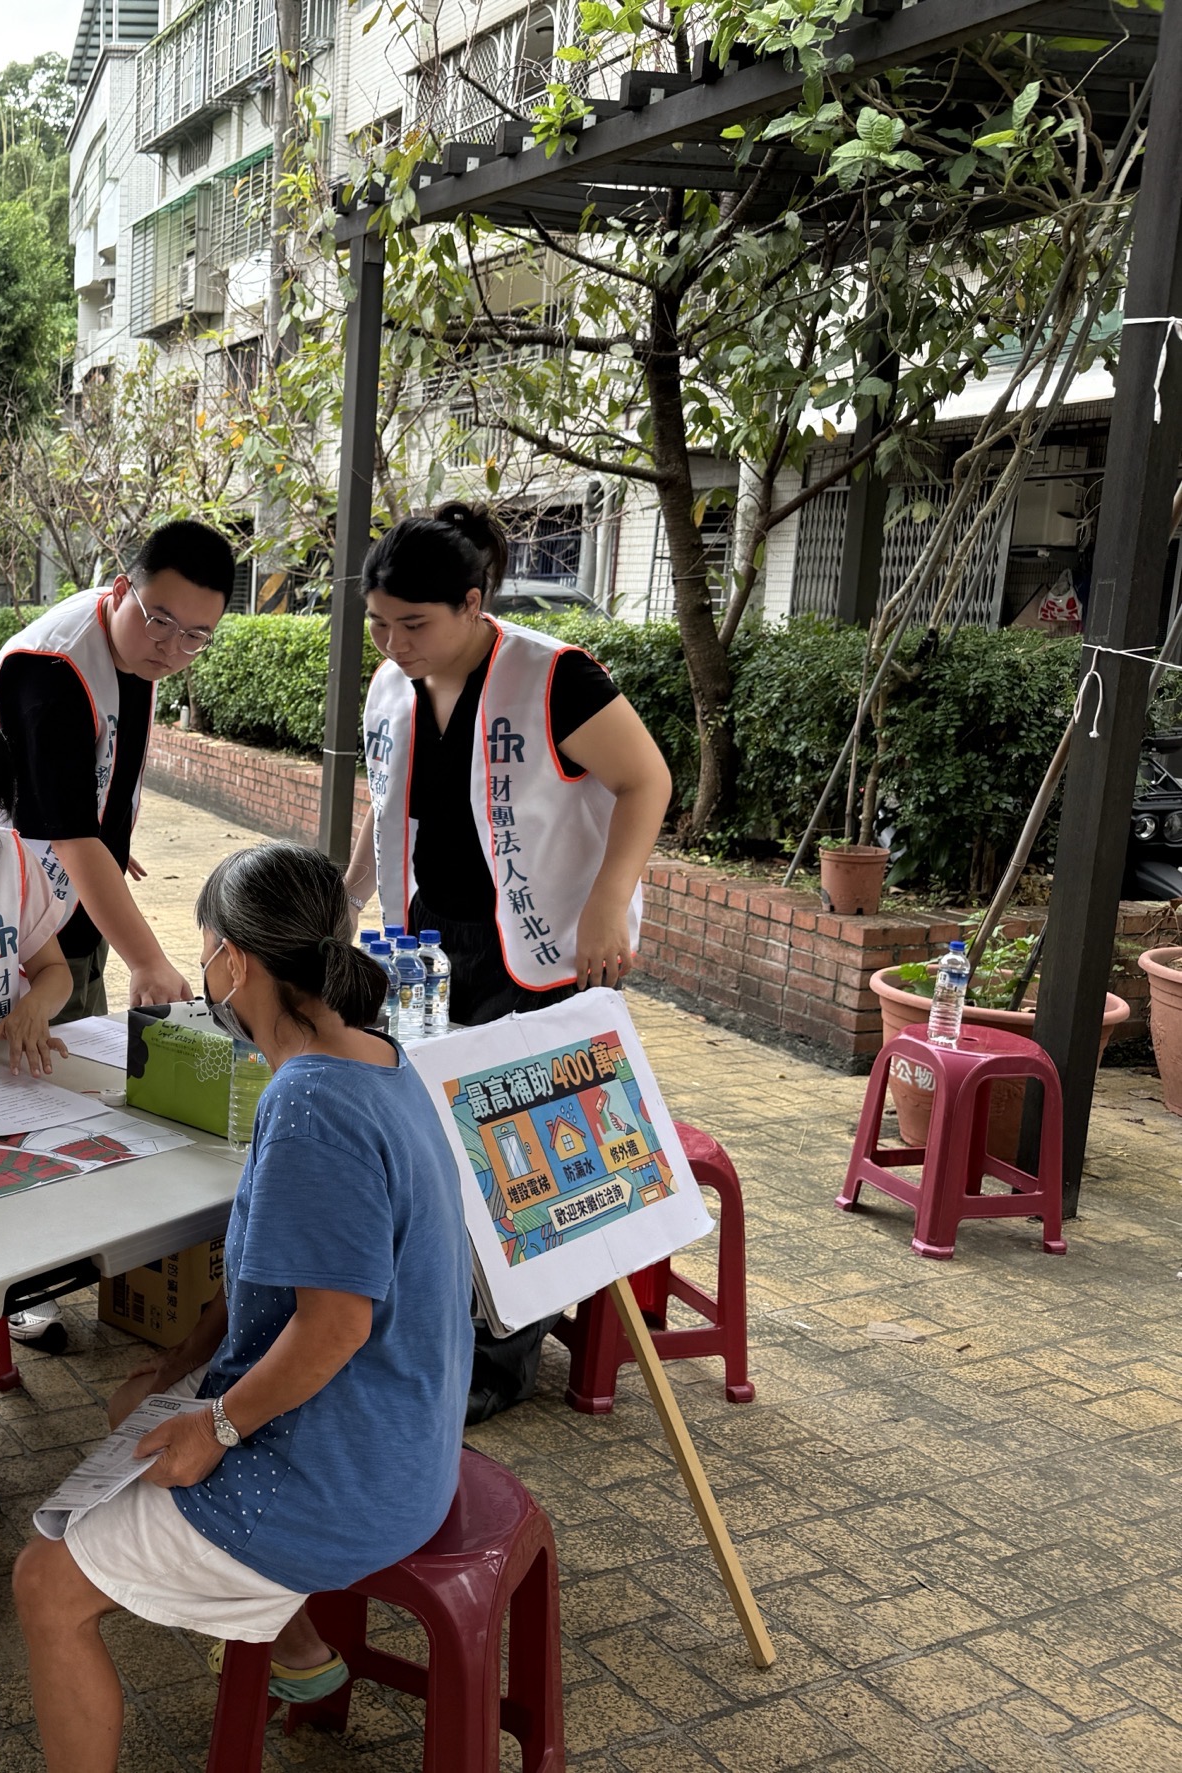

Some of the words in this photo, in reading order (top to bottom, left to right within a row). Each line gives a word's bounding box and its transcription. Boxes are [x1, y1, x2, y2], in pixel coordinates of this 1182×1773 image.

[489, 775, 562, 966] 財團法人新北市
[465, 1041, 617, 1120] 最高補助400萬
[563, 1156, 596, 1184] 防漏水
[609, 1139, 640, 1164] 修外牆
[506, 1174, 552, 1205] 增設電梯
[553, 1183, 625, 1227] 歡迎來攤位洽詢
